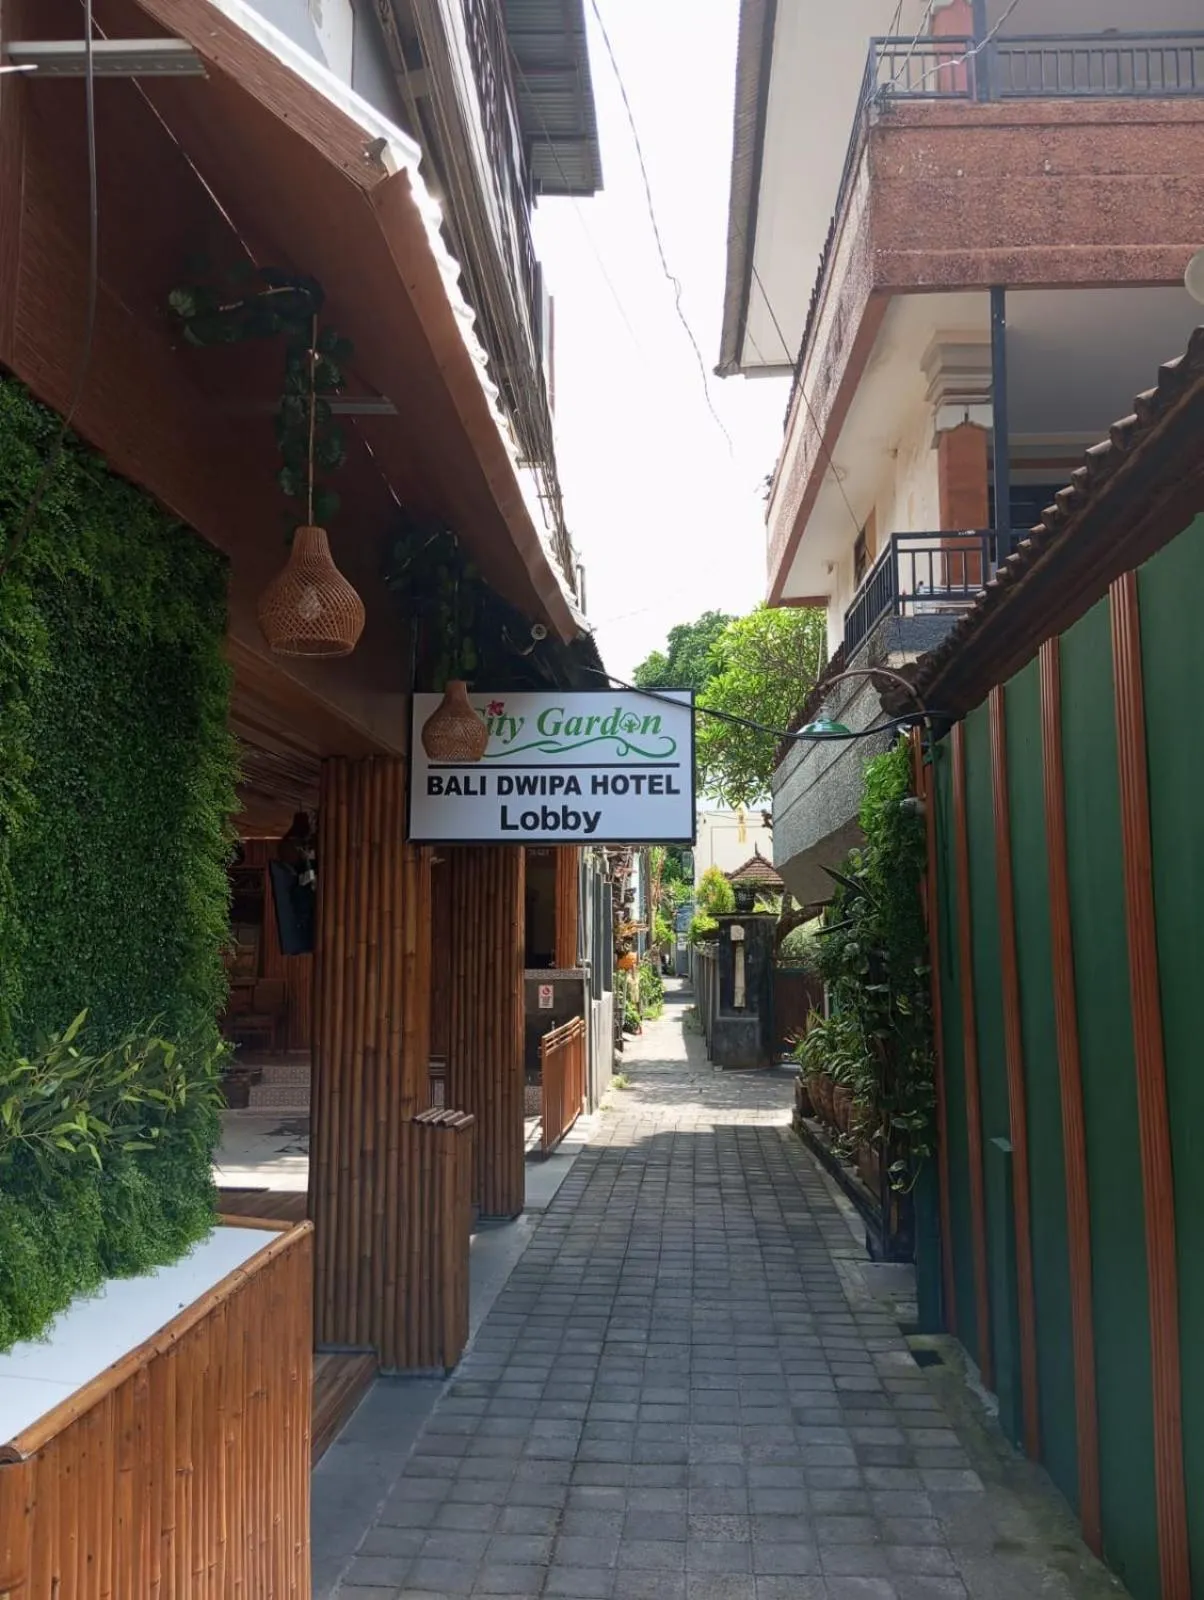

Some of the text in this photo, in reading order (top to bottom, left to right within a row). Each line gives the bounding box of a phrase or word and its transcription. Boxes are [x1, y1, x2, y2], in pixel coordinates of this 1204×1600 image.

[474, 706, 525, 744] ity
[427, 774, 681, 796] BALI DWIPA HOTEL
[500, 804, 602, 834] Lobby
